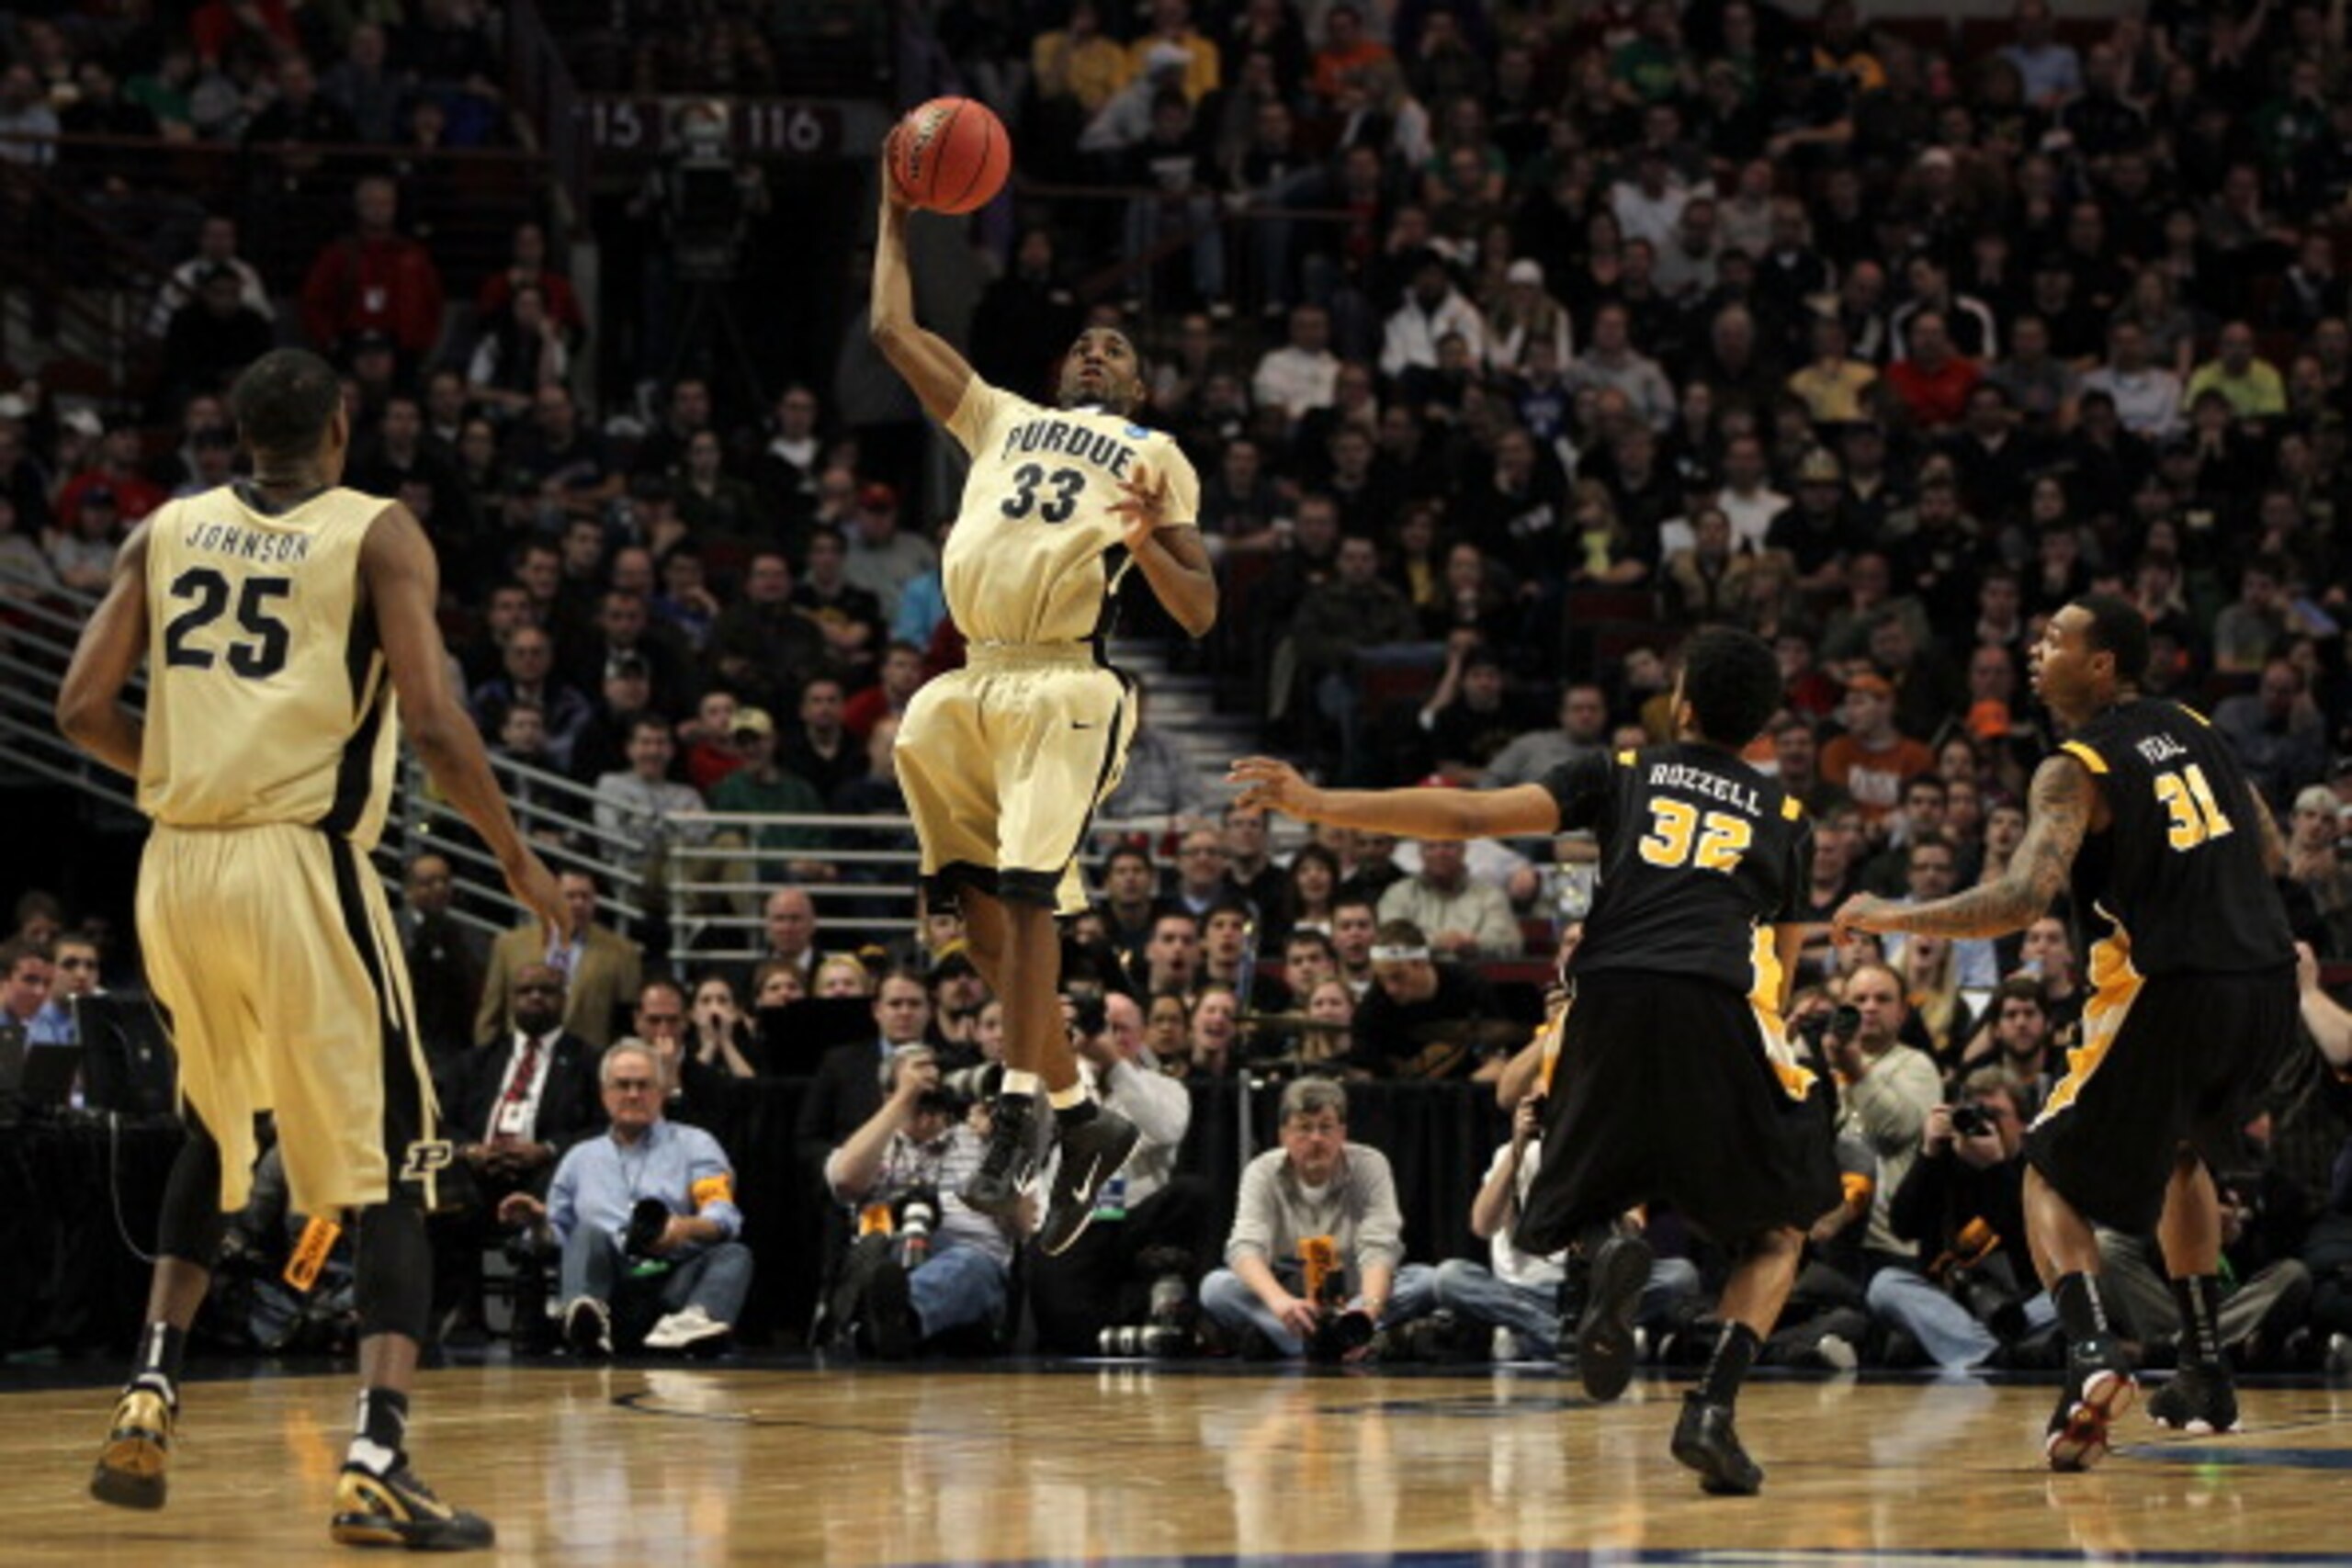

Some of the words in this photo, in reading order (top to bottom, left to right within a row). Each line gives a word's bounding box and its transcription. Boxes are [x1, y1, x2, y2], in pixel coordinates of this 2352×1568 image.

[749, 101, 824, 153] 116
[1001, 419, 1136, 479] PURDUE
[1001, 463, 1086, 524] 33
[186, 522, 311, 563] JOHNSON
[164, 566, 290, 682] 25
[1647, 761, 1762, 818] ROZZELL
[2154, 759, 2234, 852] 31
[1638, 795, 1753, 876] 32
